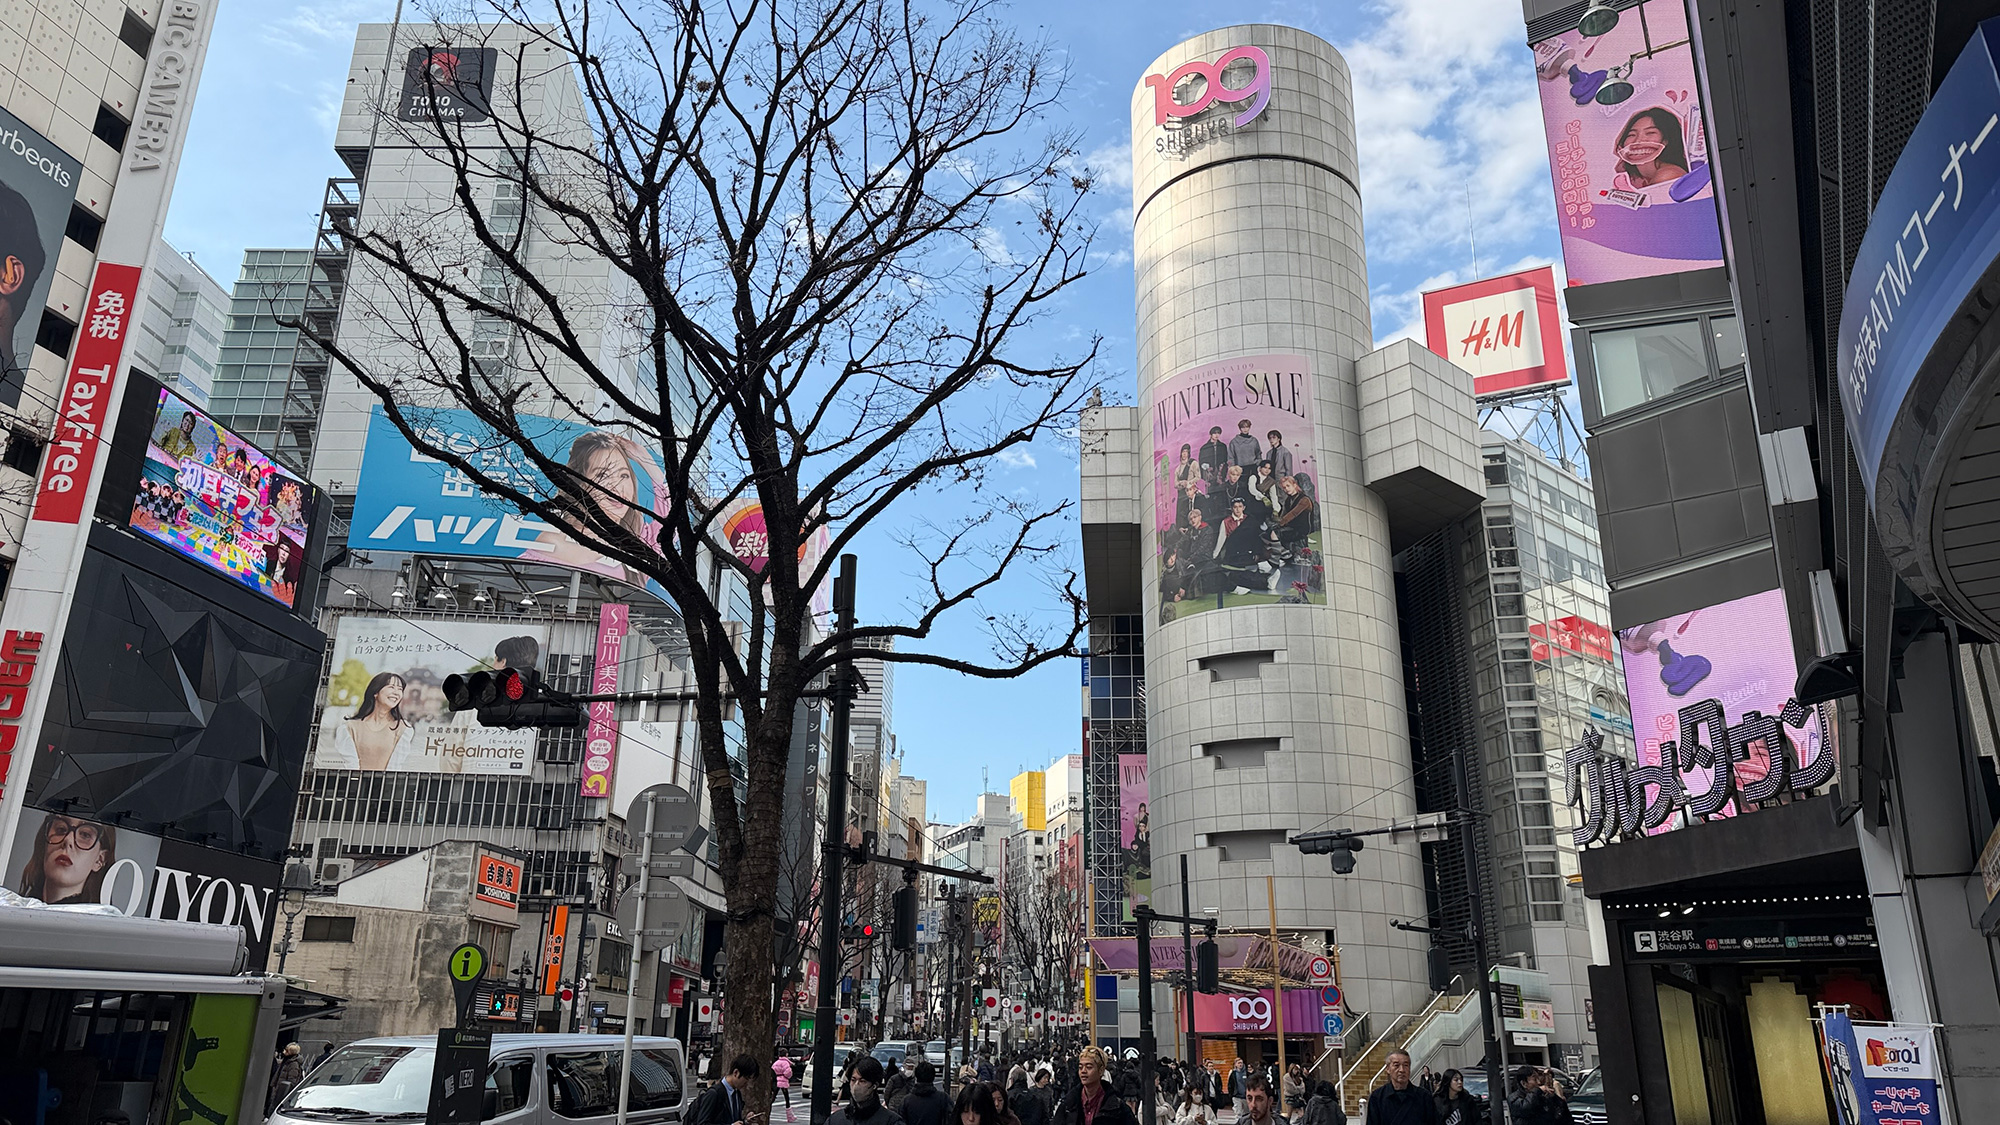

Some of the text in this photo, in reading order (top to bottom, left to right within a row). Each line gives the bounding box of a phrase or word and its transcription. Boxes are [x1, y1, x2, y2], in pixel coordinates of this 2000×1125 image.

[130, 0, 199, 172] BIC CAMERA
[1145, 45, 1271, 127] 109
[1155, 117, 1230, 153] SHIBUYA
[1849, 113, 1998, 415] みずほATMコーナー
[89, 289, 126, 341] 免税
[1460, 309, 1525, 358] H&M
[1189, 363, 1254, 382] SHIBUYA109
[1156, 372, 1305, 443] WINTER SALE
[181, 461, 283, 542] 初耳学フェス
[357, 634, 408, 644] ちょっとだけ
[442, 743, 525, 759] Healmate
[1123, 765, 1148, 789] WIN
[1565, 697, 1837, 846] グルメタウン
[487, 862, 514, 888] 吉野家
[1658, 930, 1694, 941] 渋谷駅
[1659, 942, 1703, 952] Shibuya Sta.
[1314, 962, 1326, 973] 30
[1229, 996, 1272, 1030] 109
[1233, 1022, 1258, 1030] SHIBUYA
[1327, 1019, 1336, 1033] P
